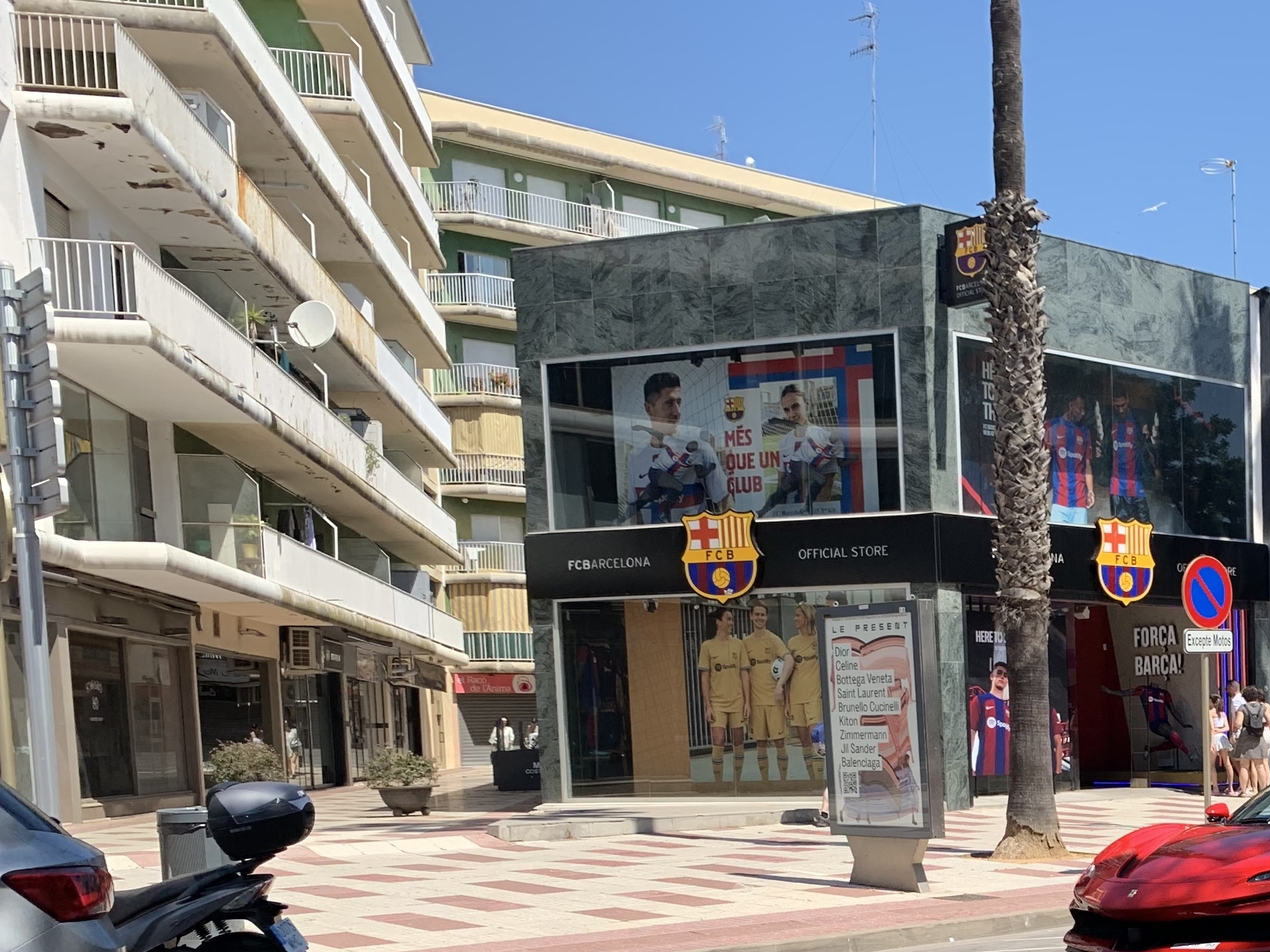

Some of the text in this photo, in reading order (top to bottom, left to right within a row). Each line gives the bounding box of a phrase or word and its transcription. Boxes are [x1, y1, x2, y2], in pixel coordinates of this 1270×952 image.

[724, 424, 752, 448] MÉS
[726, 450, 781, 472] QUE UN
[726, 475, 763, 495] CLUB
[706, 550, 734, 560] FCB
[798, 545, 889, 560] OFFICIAL STORE
[568, 556, 650, 570] FCBARCELONA
[1115, 556, 1138, 565] FCB
[832, 622, 908, 634] LE PRESENT
[975, 630, 994, 643] HERE
[1133, 624, 1177, 652] FORÇA
[1188, 634, 1232, 648] Excepte Motos
[834, 646, 850, 657] Dior
[835, 660, 858, 671] Celine
[1134, 654, 1182, 681] BARÇA!
[836, 673, 892, 687] Bottega Veneta
[837, 687, 886, 698] Saint Laurent
[838, 701, 899, 712] Brunello Cucinelli
[839, 716, 858, 726] Kiton
[840, 730, 887, 740] Zimmermann
[841, 743, 876, 754] Jil Sander
[842, 757, 880, 770] Balenciaga
